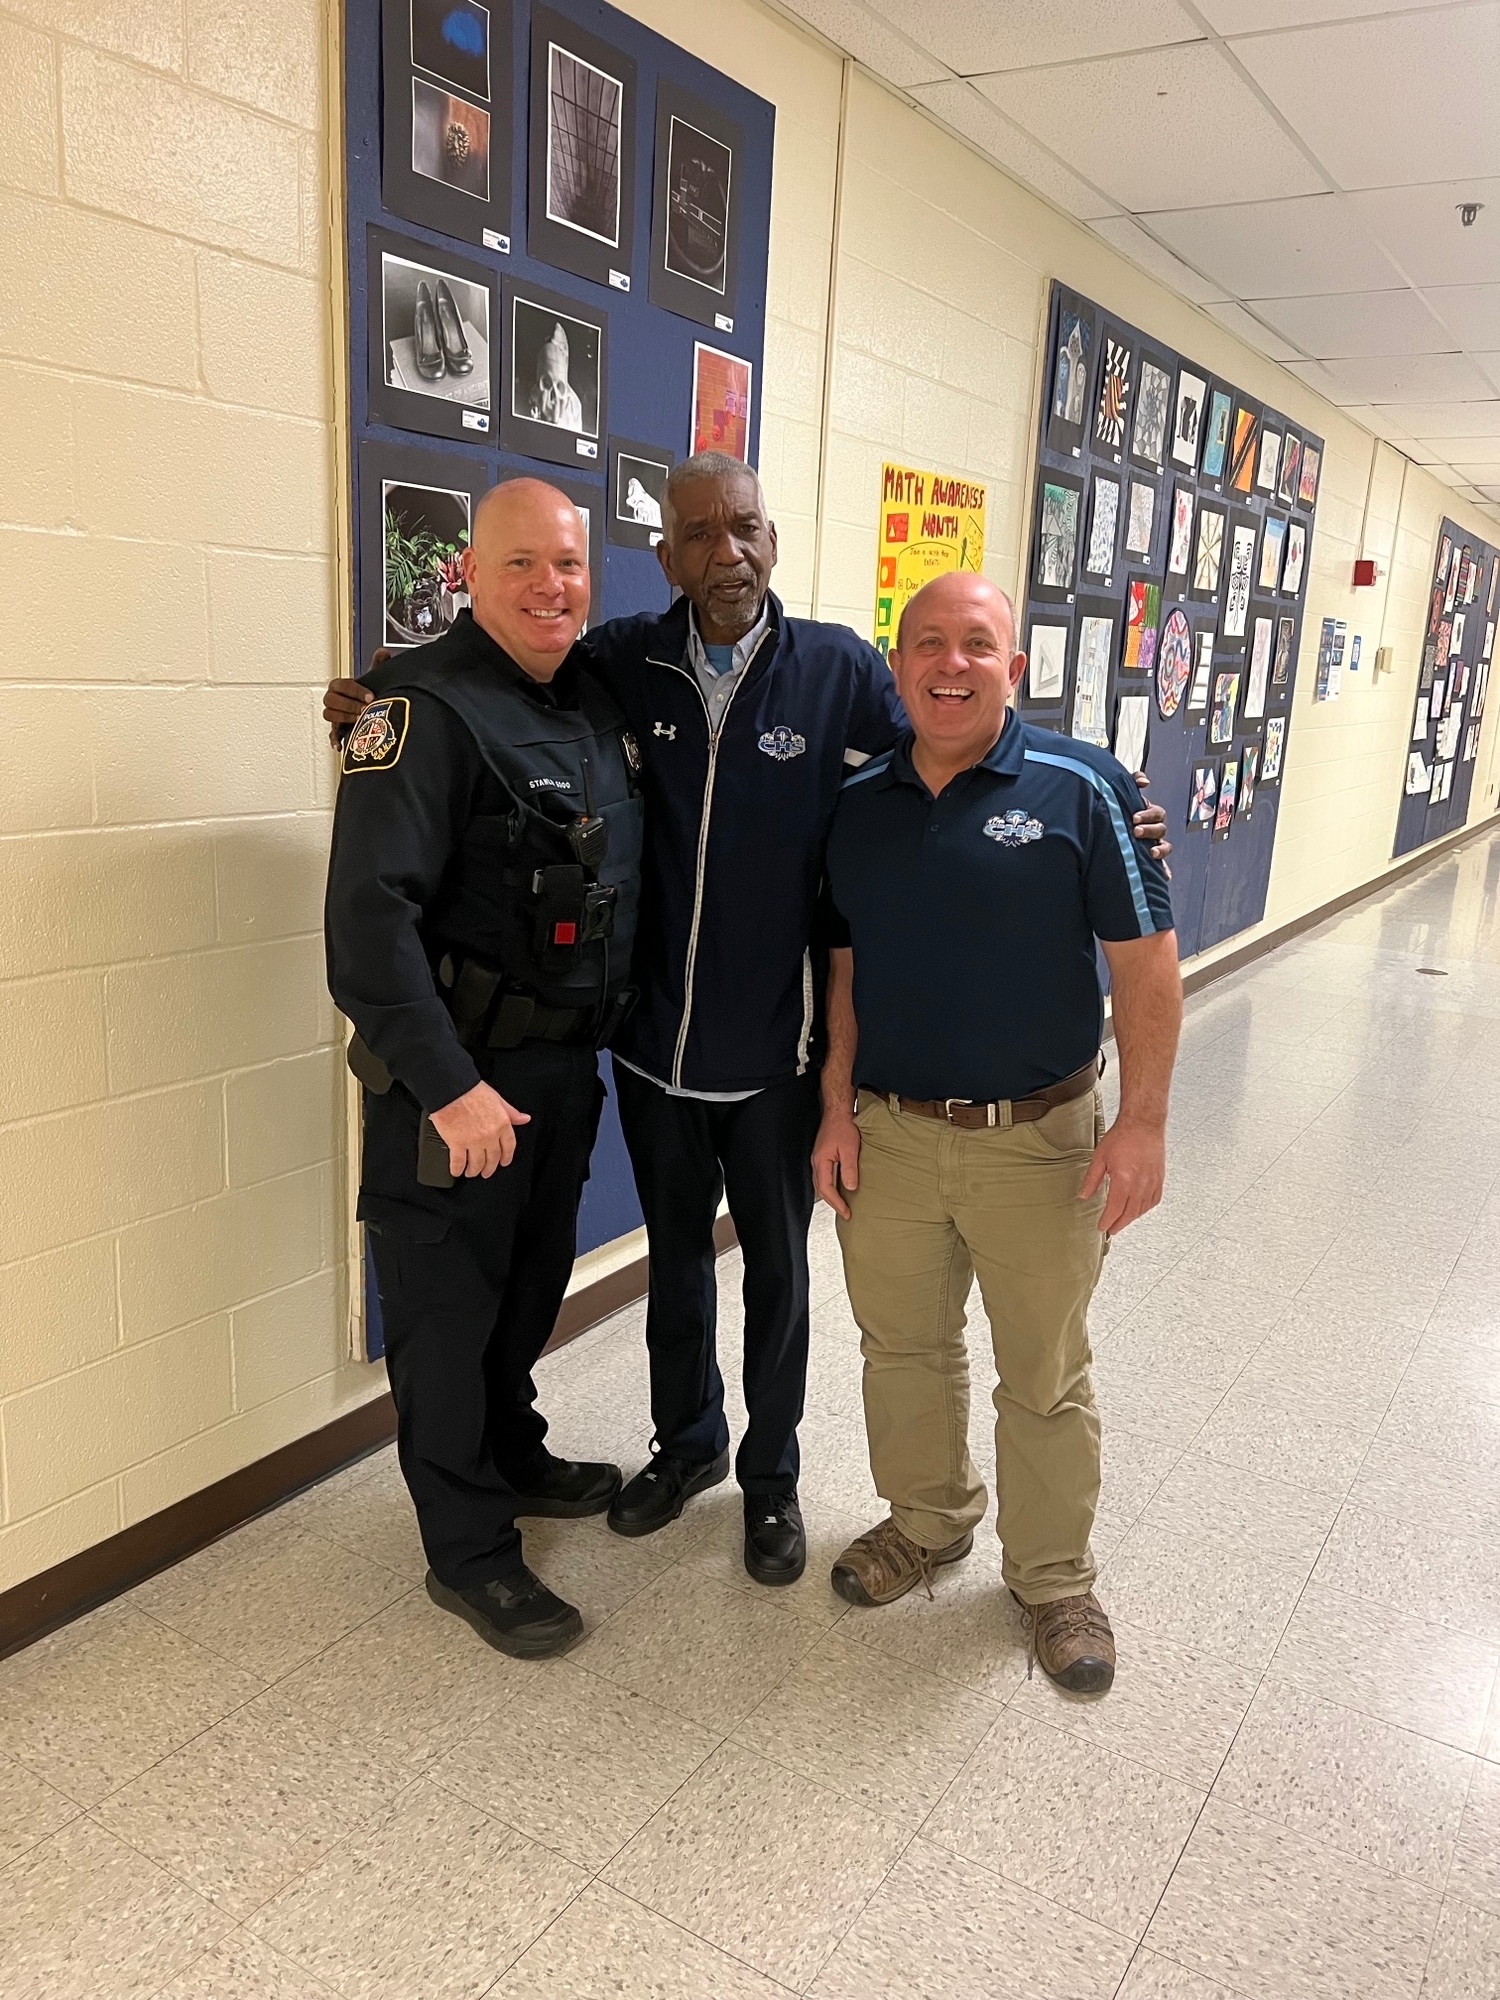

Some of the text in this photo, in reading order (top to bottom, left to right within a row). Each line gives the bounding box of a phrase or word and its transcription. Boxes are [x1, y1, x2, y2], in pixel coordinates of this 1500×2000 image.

[884, 466, 984, 509] MATH AWARENESS
[920, 510, 959, 539] MONTH
[363, 710, 387, 721] POLICE
